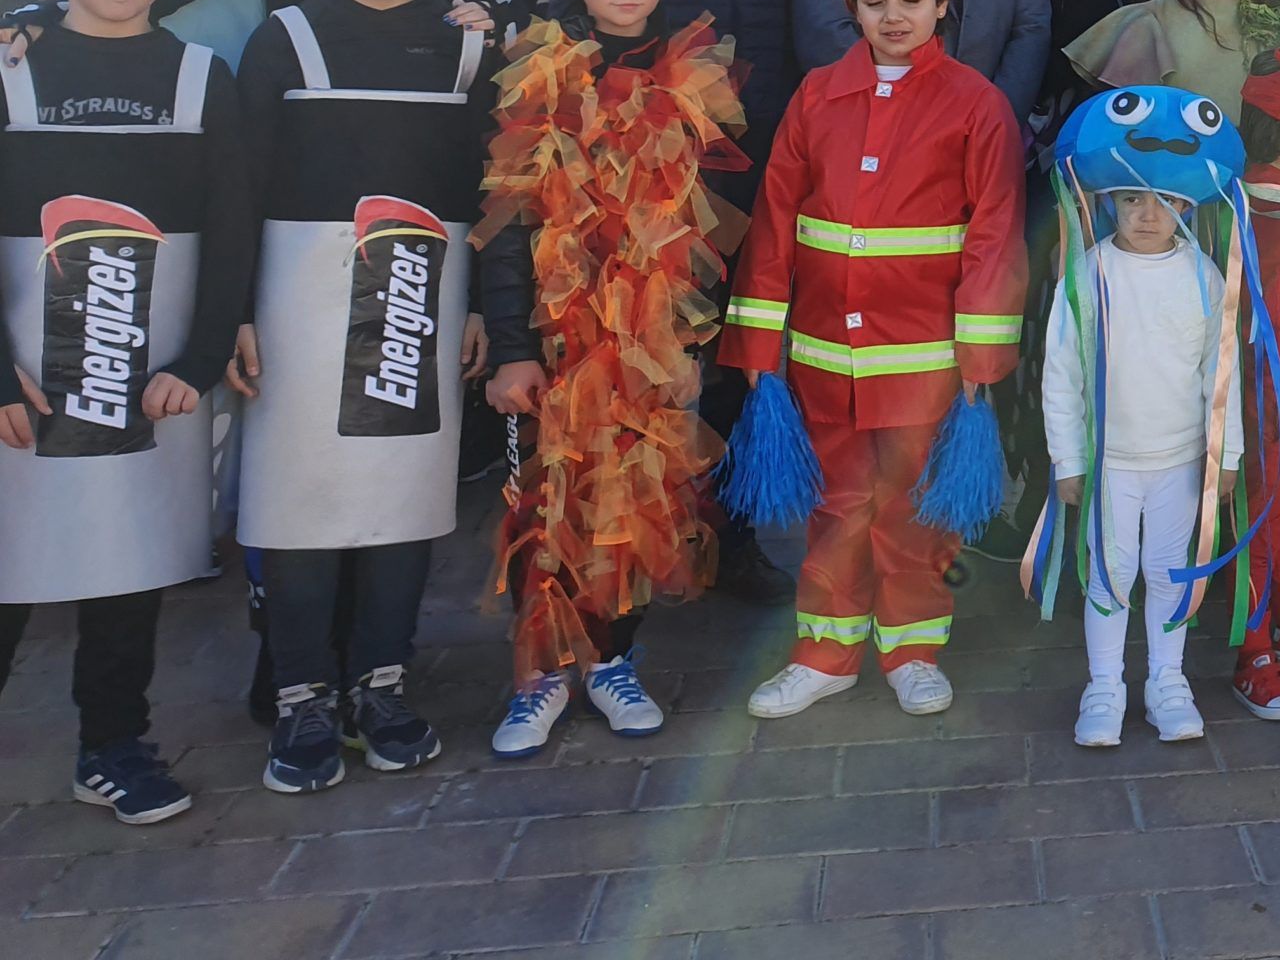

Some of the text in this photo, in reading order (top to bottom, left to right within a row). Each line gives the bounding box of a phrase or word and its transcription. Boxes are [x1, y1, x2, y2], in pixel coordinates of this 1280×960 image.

[38, 106, 57, 122] VI
[61, 97, 153, 120] STRAUSS
[65, 246, 145, 429] Energizer
[364, 242, 434, 410] Energizer
